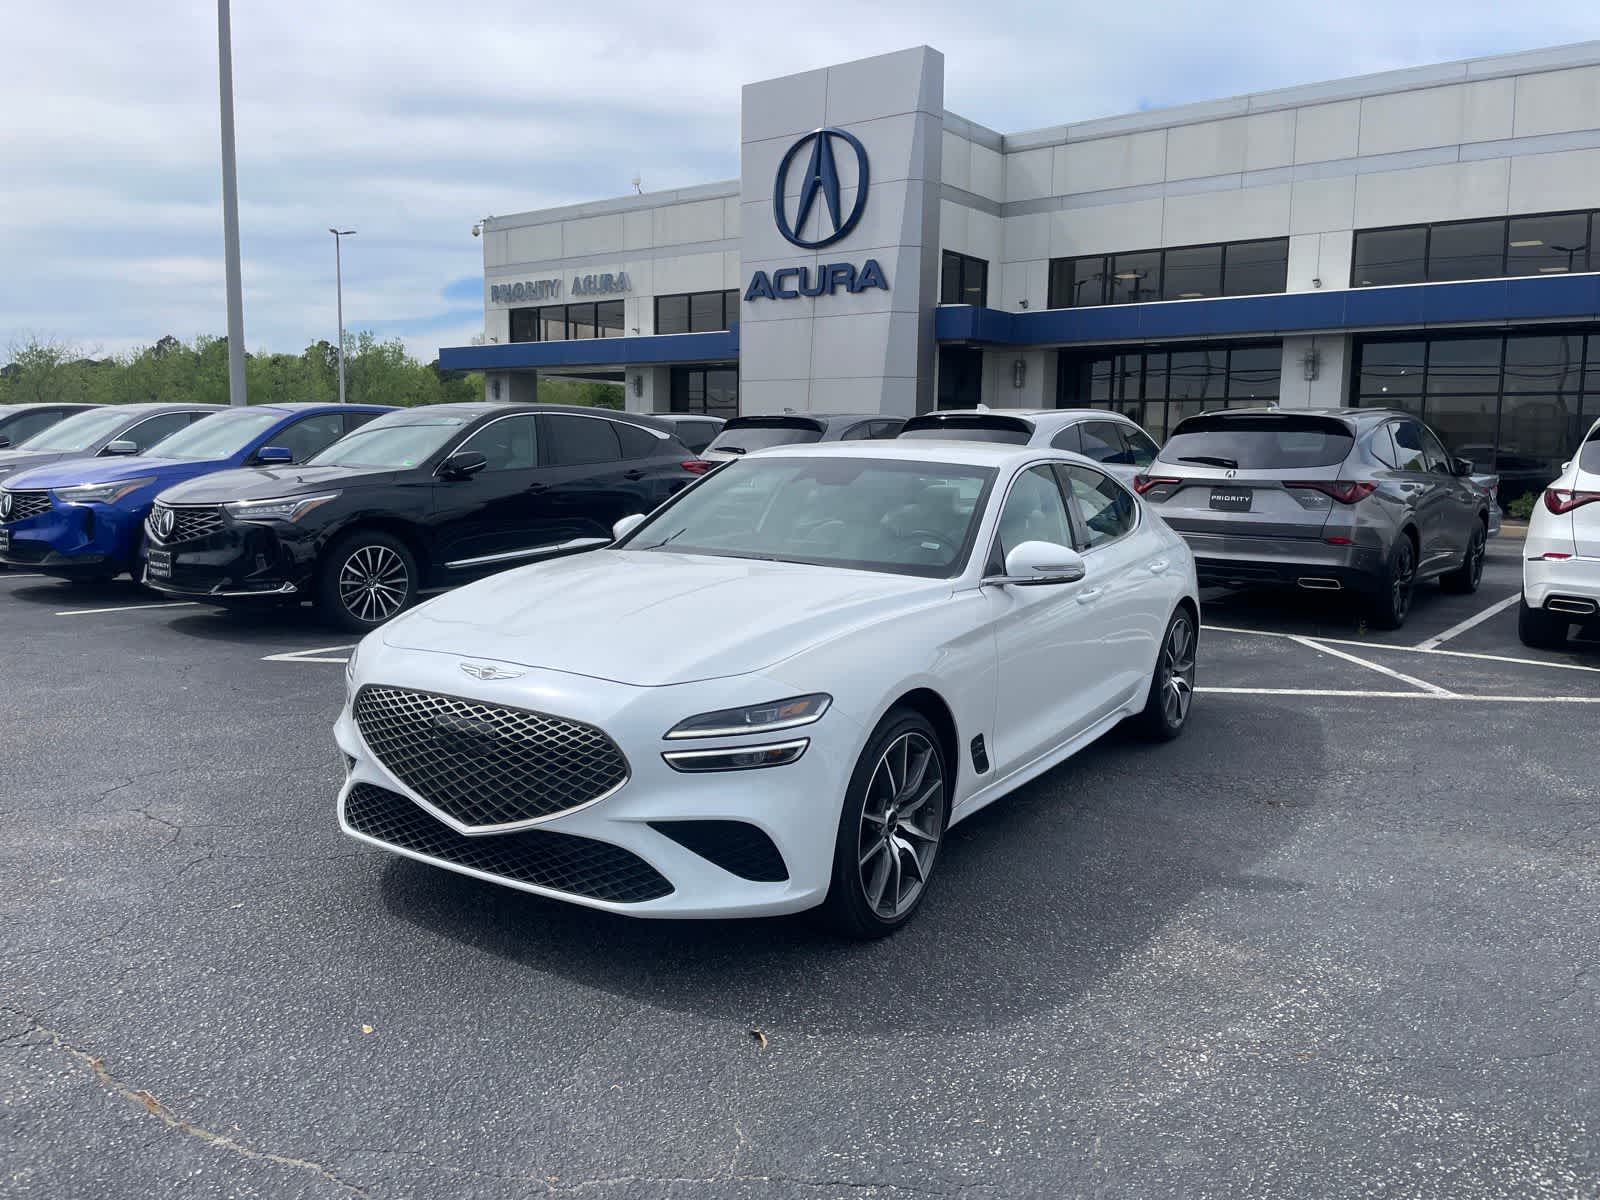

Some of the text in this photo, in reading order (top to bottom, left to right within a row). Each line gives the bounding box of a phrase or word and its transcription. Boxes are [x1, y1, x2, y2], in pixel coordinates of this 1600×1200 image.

[490, 271, 632, 303] PRIORITY ACURA
[744, 259, 888, 301] ACURA
